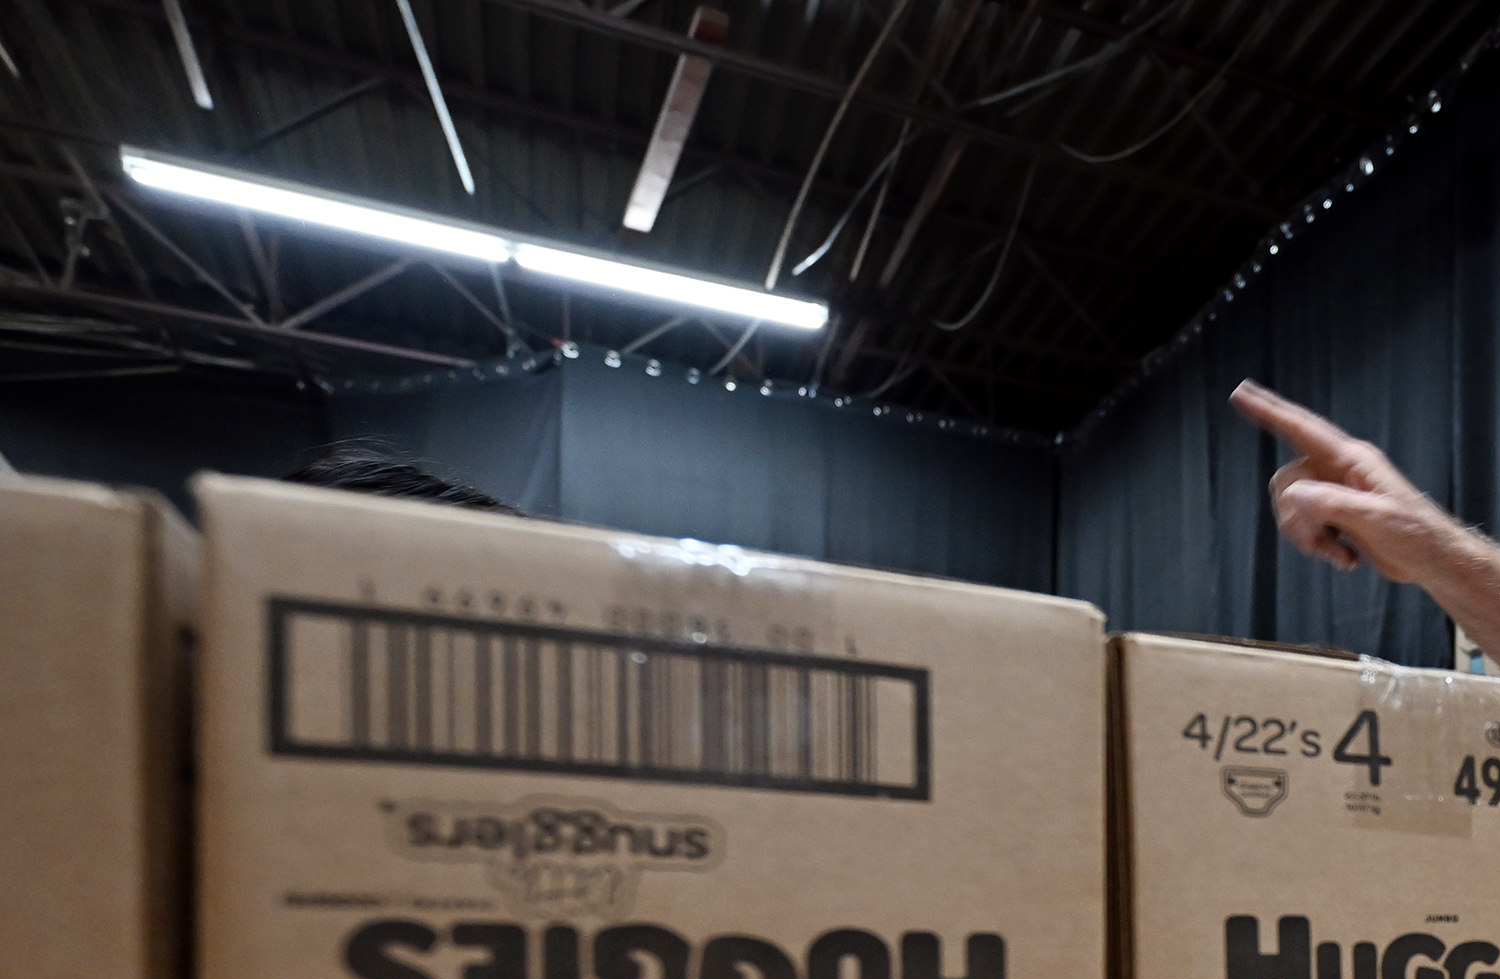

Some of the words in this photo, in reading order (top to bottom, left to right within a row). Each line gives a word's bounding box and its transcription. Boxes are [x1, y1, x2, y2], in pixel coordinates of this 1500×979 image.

[1183, 712, 1322, 761] 4/22's
[1333, 710, 1392, 786] 4
[408, 809, 711, 861] snugglers
